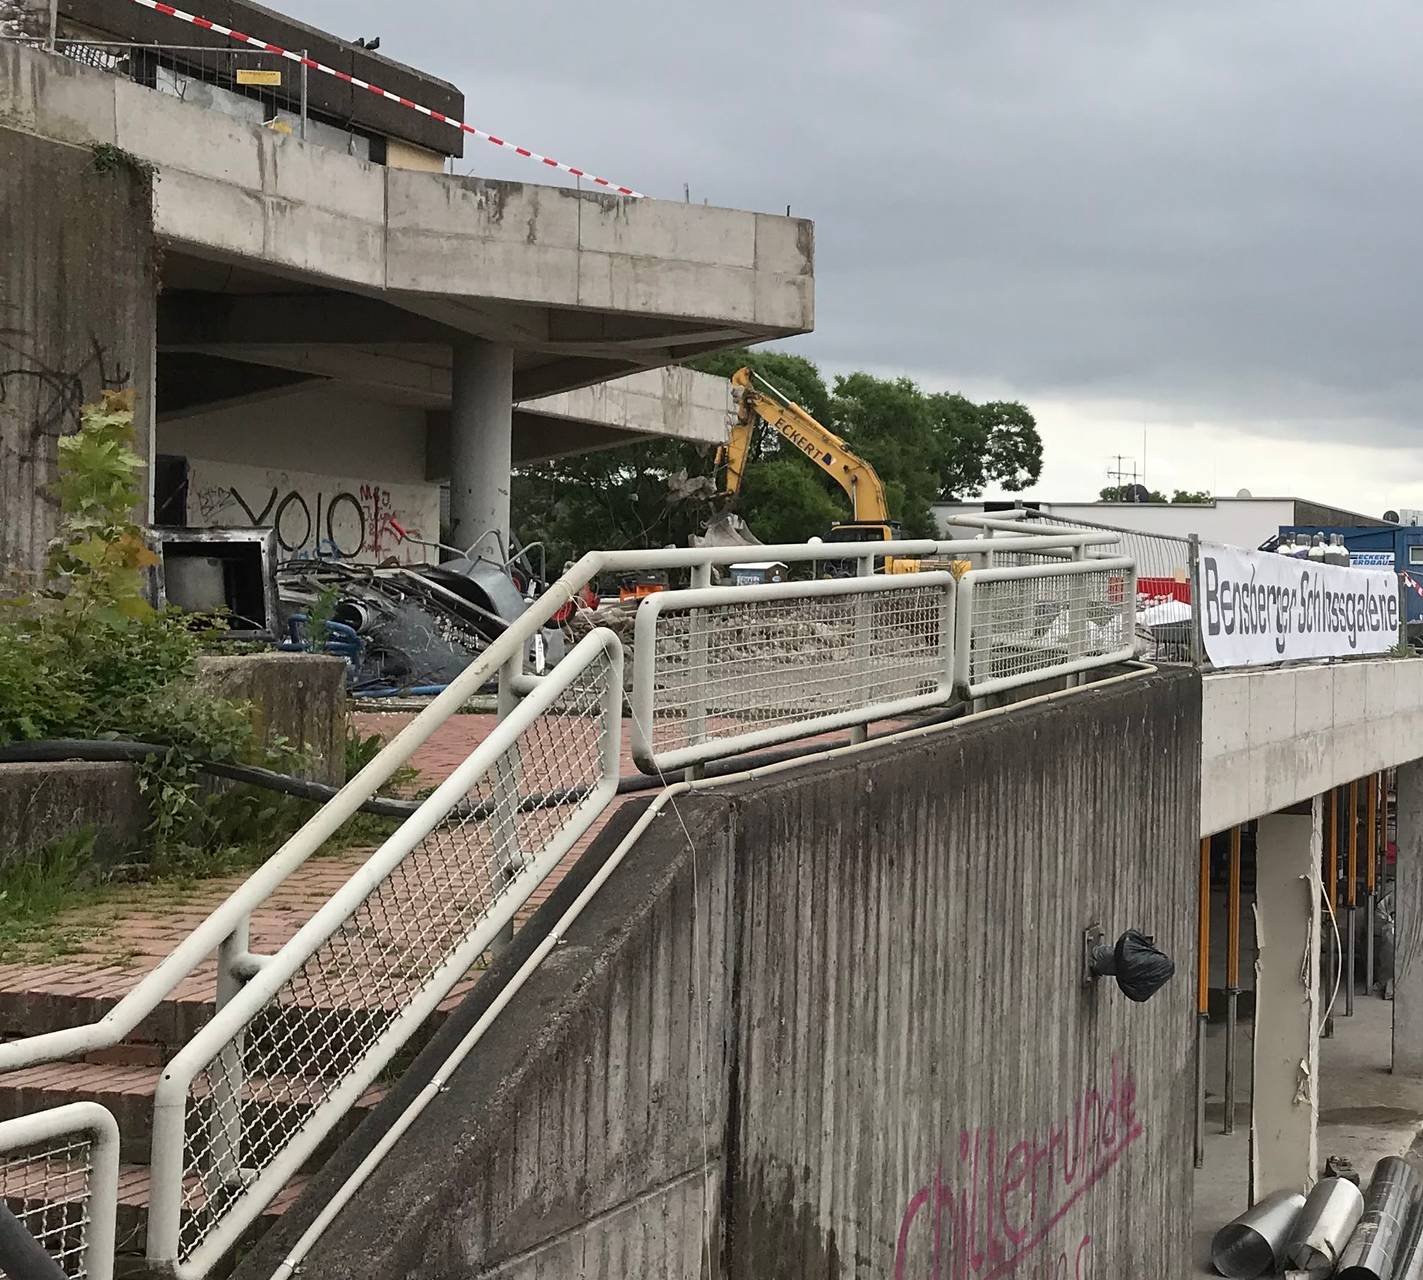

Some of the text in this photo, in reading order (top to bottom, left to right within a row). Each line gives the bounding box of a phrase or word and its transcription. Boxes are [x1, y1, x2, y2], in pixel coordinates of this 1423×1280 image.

[774, 417, 823, 460] ECKERT
[1204, 556, 1397, 654] Bensberger Schlossgalerie
